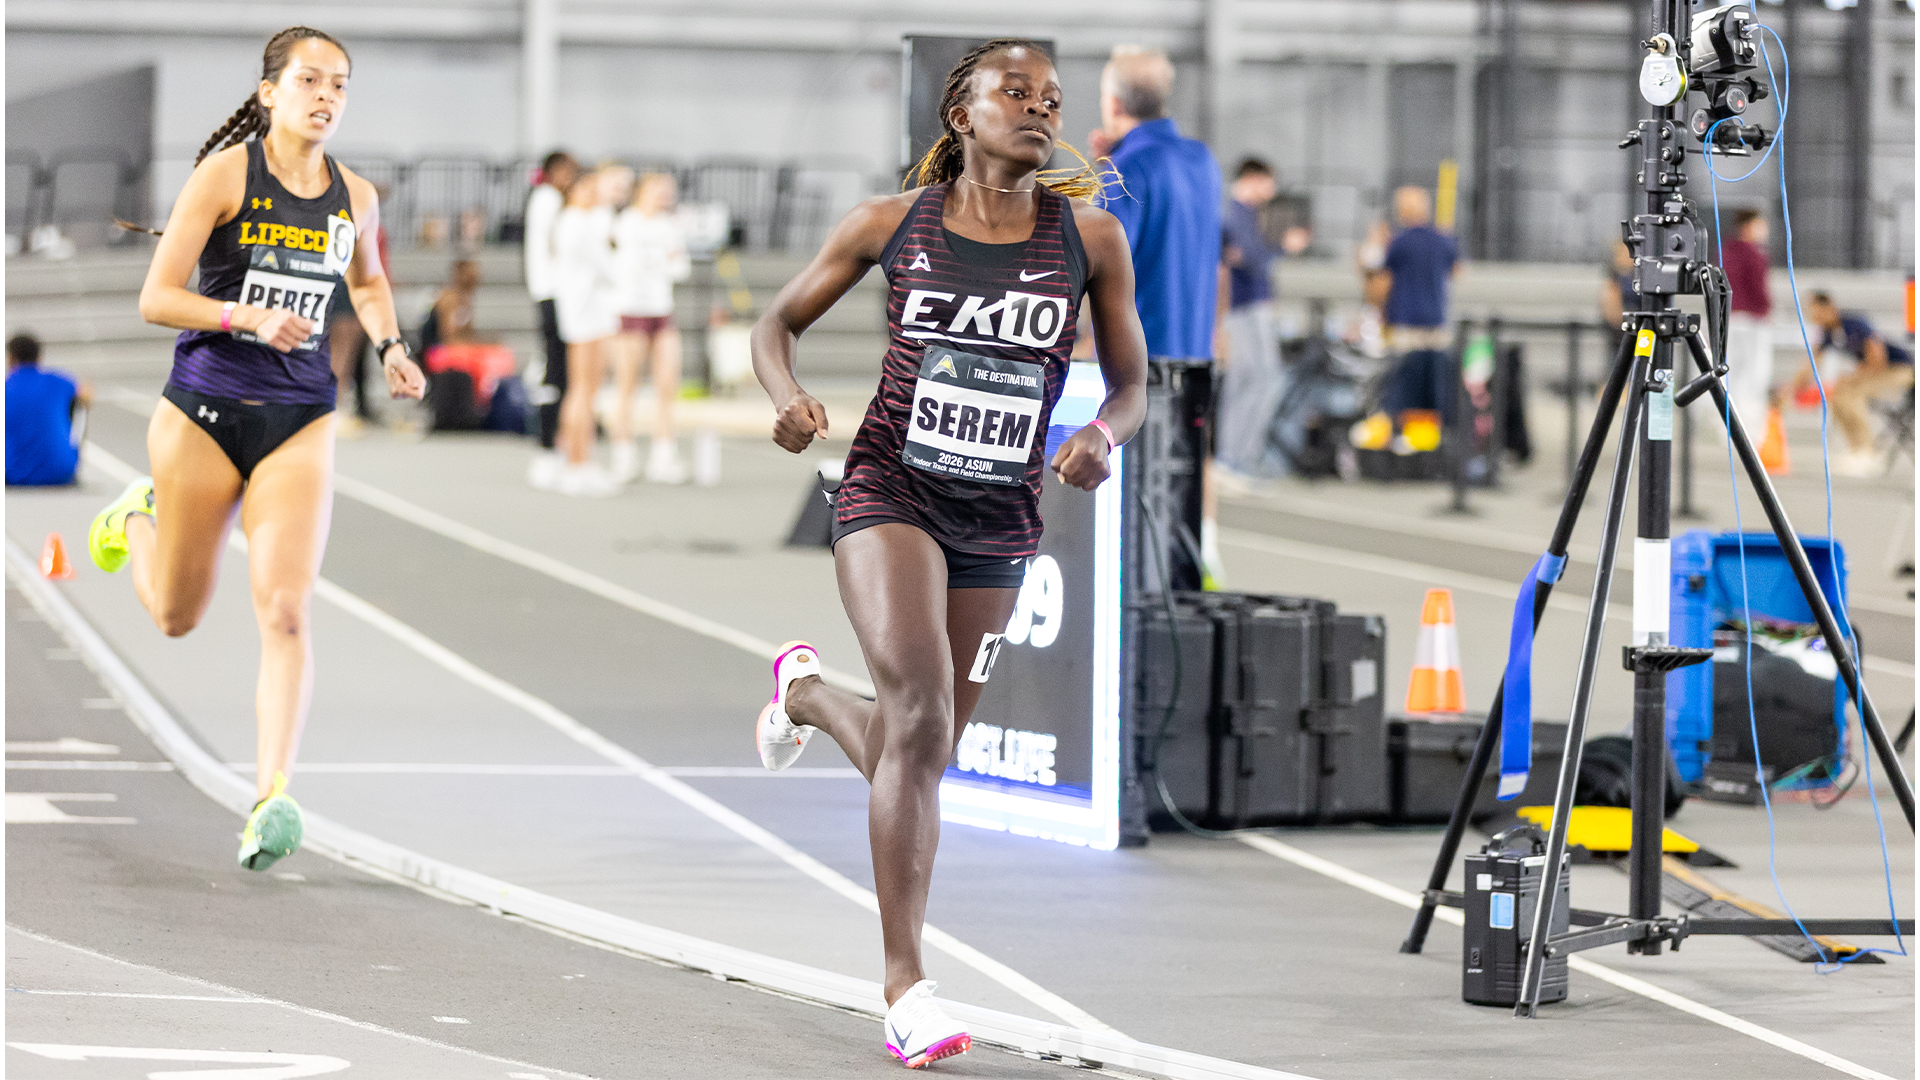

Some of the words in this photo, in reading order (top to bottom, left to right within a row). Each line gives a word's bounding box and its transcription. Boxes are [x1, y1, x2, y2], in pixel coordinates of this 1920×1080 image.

[333, 223, 351, 263] 6
[246, 283, 326, 322] PEREZ
[1011, 296, 1060, 342] 10
[973, 368, 989, 381] THE
[989, 371, 1038, 388] DESTINATION.
[916, 397, 1032, 449] SEREM
[913, 456, 933, 467] Indoor
[932, 461, 948, 471] Track
[948, 467, 960, 475] and
[960, 468, 975, 478] Field
[974, 472, 1012, 483] Championship
[938, 452, 963, 468] 2026
[965, 460, 993, 472] ASUN
